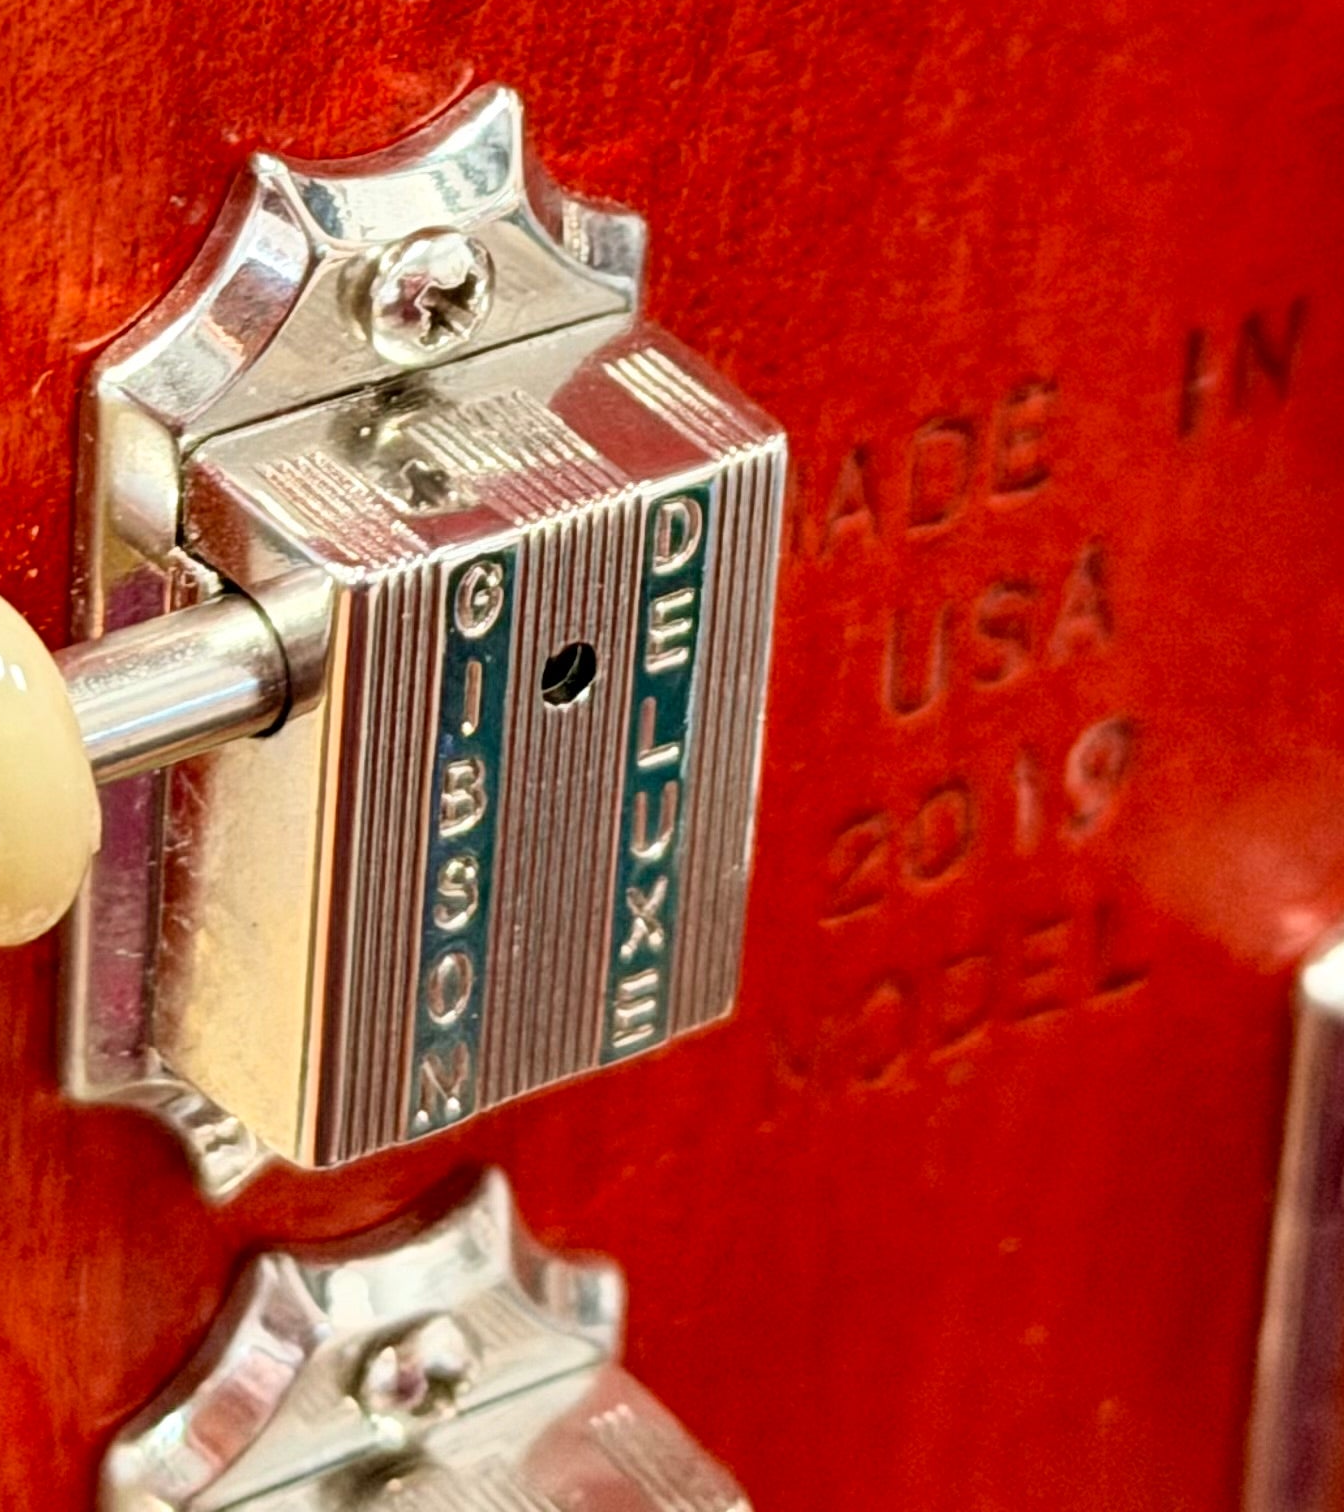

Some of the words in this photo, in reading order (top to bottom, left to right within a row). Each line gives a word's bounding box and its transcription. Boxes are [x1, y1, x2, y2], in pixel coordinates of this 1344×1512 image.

[1176, 296, 1308, 442] IN
[880, 538, 1116, 718] USA
[411, 557, 506, 1128] GIBSON
[610, 494, 704, 1050] DELUXE
[816, 716, 1138, 928] 2019
